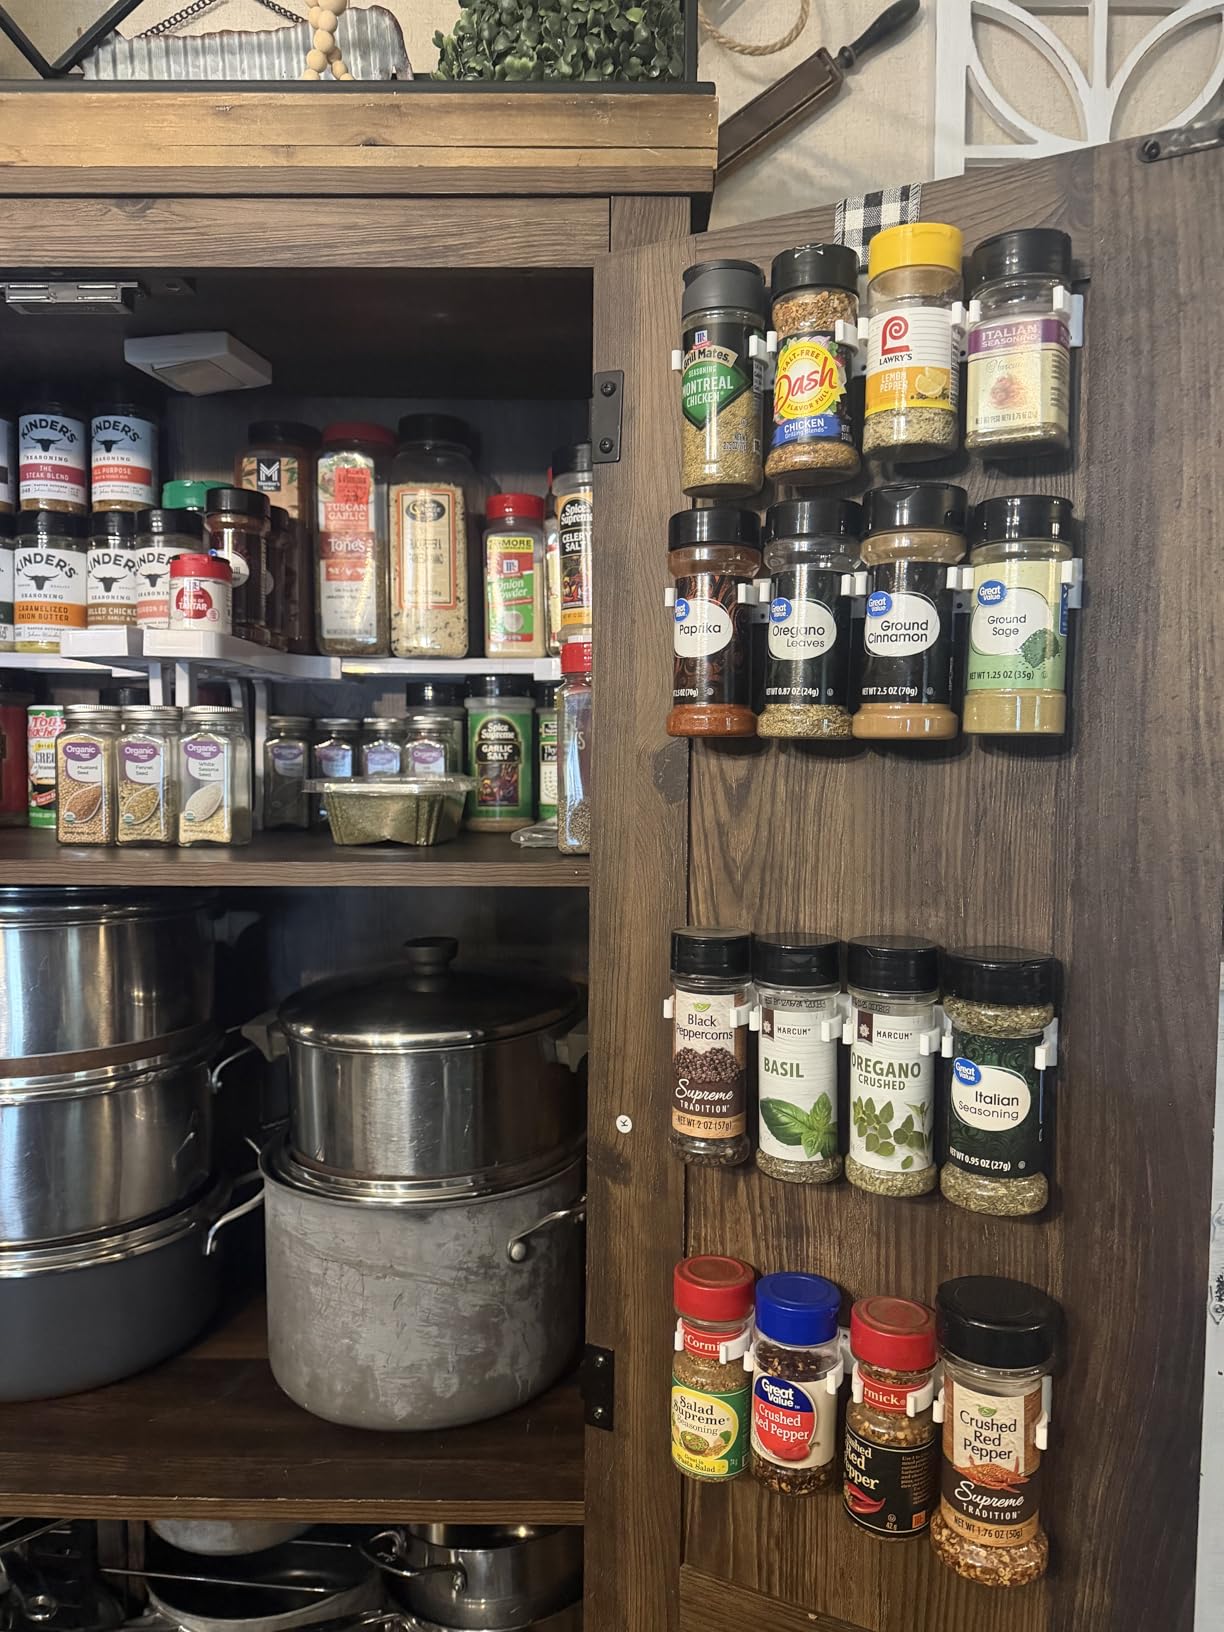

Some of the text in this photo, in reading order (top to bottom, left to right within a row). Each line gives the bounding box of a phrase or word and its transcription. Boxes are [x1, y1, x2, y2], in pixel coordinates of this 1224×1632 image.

[983, 324, 1037, 341] ITALIAN
[982, 333, 1038, 348] SEASONING
[698, 348, 730, 364] Mates
[783, 349, 821, 372] SALT-FREE
[880, 353, 913, 366] LAWRY'S
[689, 365, 718, 378] SEASONING
[882, 371, 907, 383] LEMON
[775, 356, 838, 415] Dash
[687, 391, 720, 408] CHICKEN
[787, 390, 830, 412] FLAVOR FULL
[21, 419, 77, 443] KINDER'S
[784, 418, 824, 434] CHICKEN
[26, 472, 69, 481] STEAK BLEND
[327, 503, 367, 511] TUSCAN
[562, 531, 592, 543] CELERY
[328, 536, 366, 553] Tone's
[565, 541, 587, 552] SALT
[16, 553, 76, 578] KINDER'S
[980, 586, 1002, 597] Great
[983, 594, 1002, 602] Value
[18, 605, 69, 613] CARAMELIZED
[869, 597, 887, 607] Great
[39, 613, 69, 621] BUTTER
[988, 614, 1027, 625] Ground
[679, 623, 722, 637] Paprika
[773, 625, 825, 639] Oregano
[881, 620, 929, 632] Ground
[992, 627, 1020, 638] Sage
[787, 639, 825, 648] Leaves
[868, 633, 929, 644] Cinnamon
[976, 671, 985, 680] WT
[987, 671, 1001, 680] 1.25
[1003, 671, 1013, 680] OZ
[1014, 671, 1035, 682] (35g)
[778, 688, 790, 696] 0.87
[791, 688, 801, 696] OZ
[801, 688, 819, 698] (24g)
[877, 687, 888, 696] 2.5
[888, 687, 898, 696] OZ
[899, 687, 918, 697] (70g)
[487, 722, 509, 733] Spice
[66, 745, 96, 755] Organic
[124, 746, 154, 755] Organic
[187, 744, 217, 753] Organic
[481, 744, 513, 753] GARLIC
[486, 752, 509, 760] SALT
[688, 1013, 716, 1029] Black
[777, 1027, 806, 1036] MARCUM
[876, 1030, 908, 1040] MARCUM
[764, 1057, 804, 1079] BASIL
[851, 1052, 921, 1078] OREGANO
[955, 1061, 975, 1076] Great
[858, 1073, 906, 1091] CRUSHED
[675, 1079, 734, 1104] Supreme
[975, 1091, 1019, 1107] Italian
[680, 1100, 728, 1113] TRADITION
[958, 1100, 1019, 1120] Seasoning
[686, 1117, 695, 1128] WT
[697, 1120, 702, 1129] 2
[704, 1120, 713, 1130] OZ
[714, 1120, 732, 1131] (57g)
[965, 1155, 979, 1166] 0.95
[980, 1159, 990, 1168] OZ
[991, 1160, 1011, 1172] (27g)
[761, 1379, 794, 1400] Great
[680, 1395, 714, 1416] Salad
[767, 1394, 794, 1408] Value
[673, 1401, 725, 1425] Supreme
[758, 1403, 801, 1427] Crushed
[677, 1416, 719, 1437] Seasoning
[959, 1410, 1016, 1433] Crushed
[770, 1422, 809, 1442] Pepper
[974, 1430, 1001, 1447] Red
[963, 1438, 1013, 1462] Pepper
[954, 1481, 1024, 1510] Supreme
[962, 1502, 1017, 1519] TRADITION
[954, 1514, 1023, 1541] NET WT 1.76 OZ (50g)
